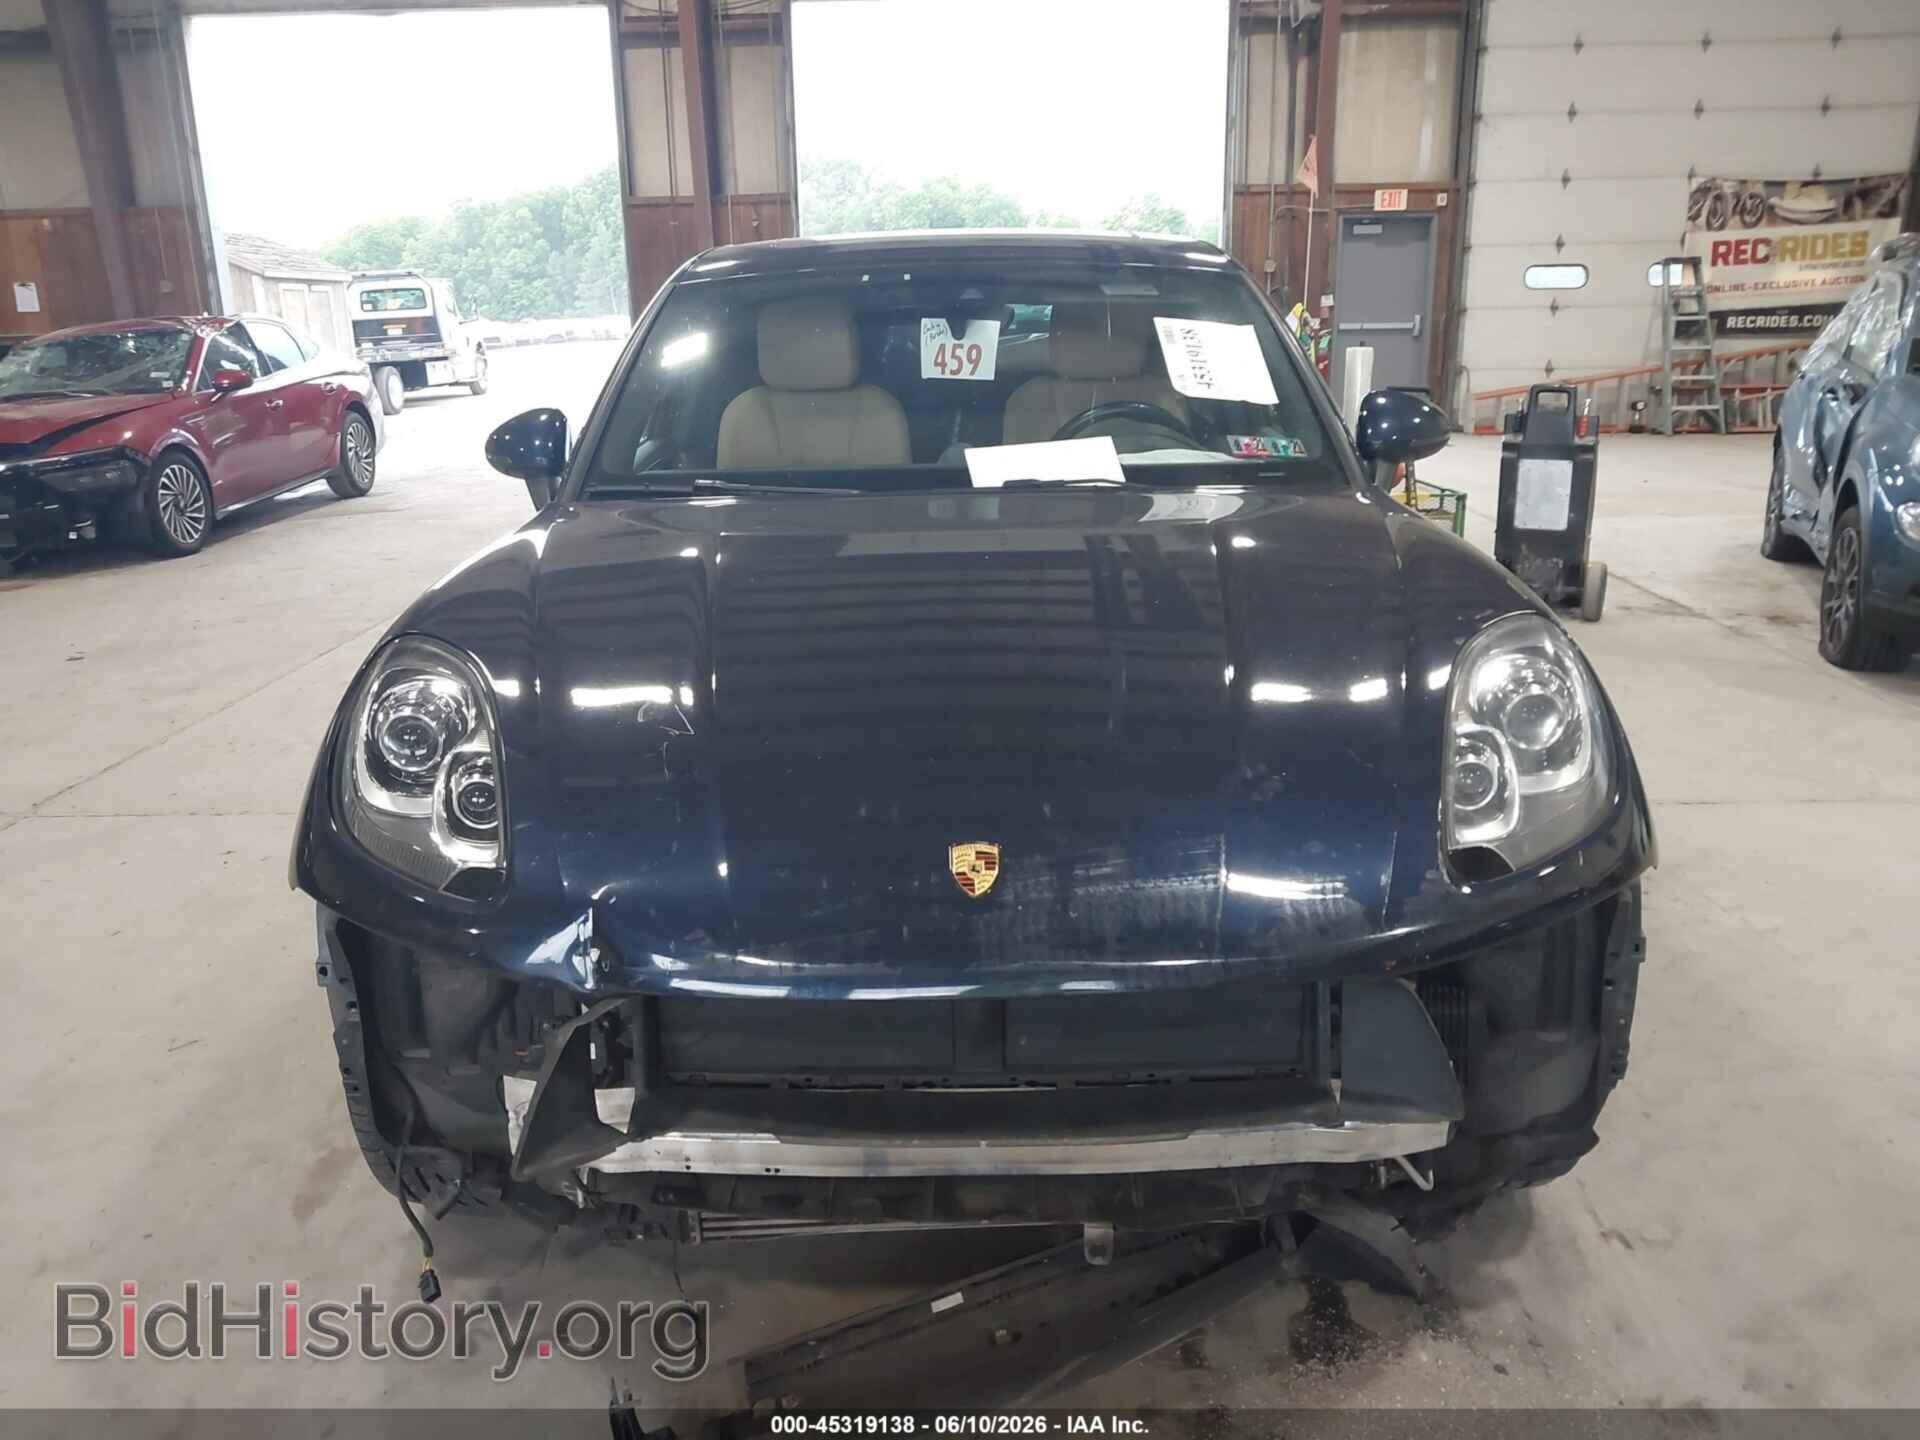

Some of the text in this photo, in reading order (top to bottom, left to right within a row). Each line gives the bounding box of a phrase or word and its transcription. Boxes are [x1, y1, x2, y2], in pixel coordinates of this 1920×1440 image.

[1380, 191, 1402, 208] EXIT
[1711, 230, 1870, 267] REC RIDES
[1706, 278, 1817, 294] ONLINE-EXCLUSIVE
[933, 343, 982, 376] 459
